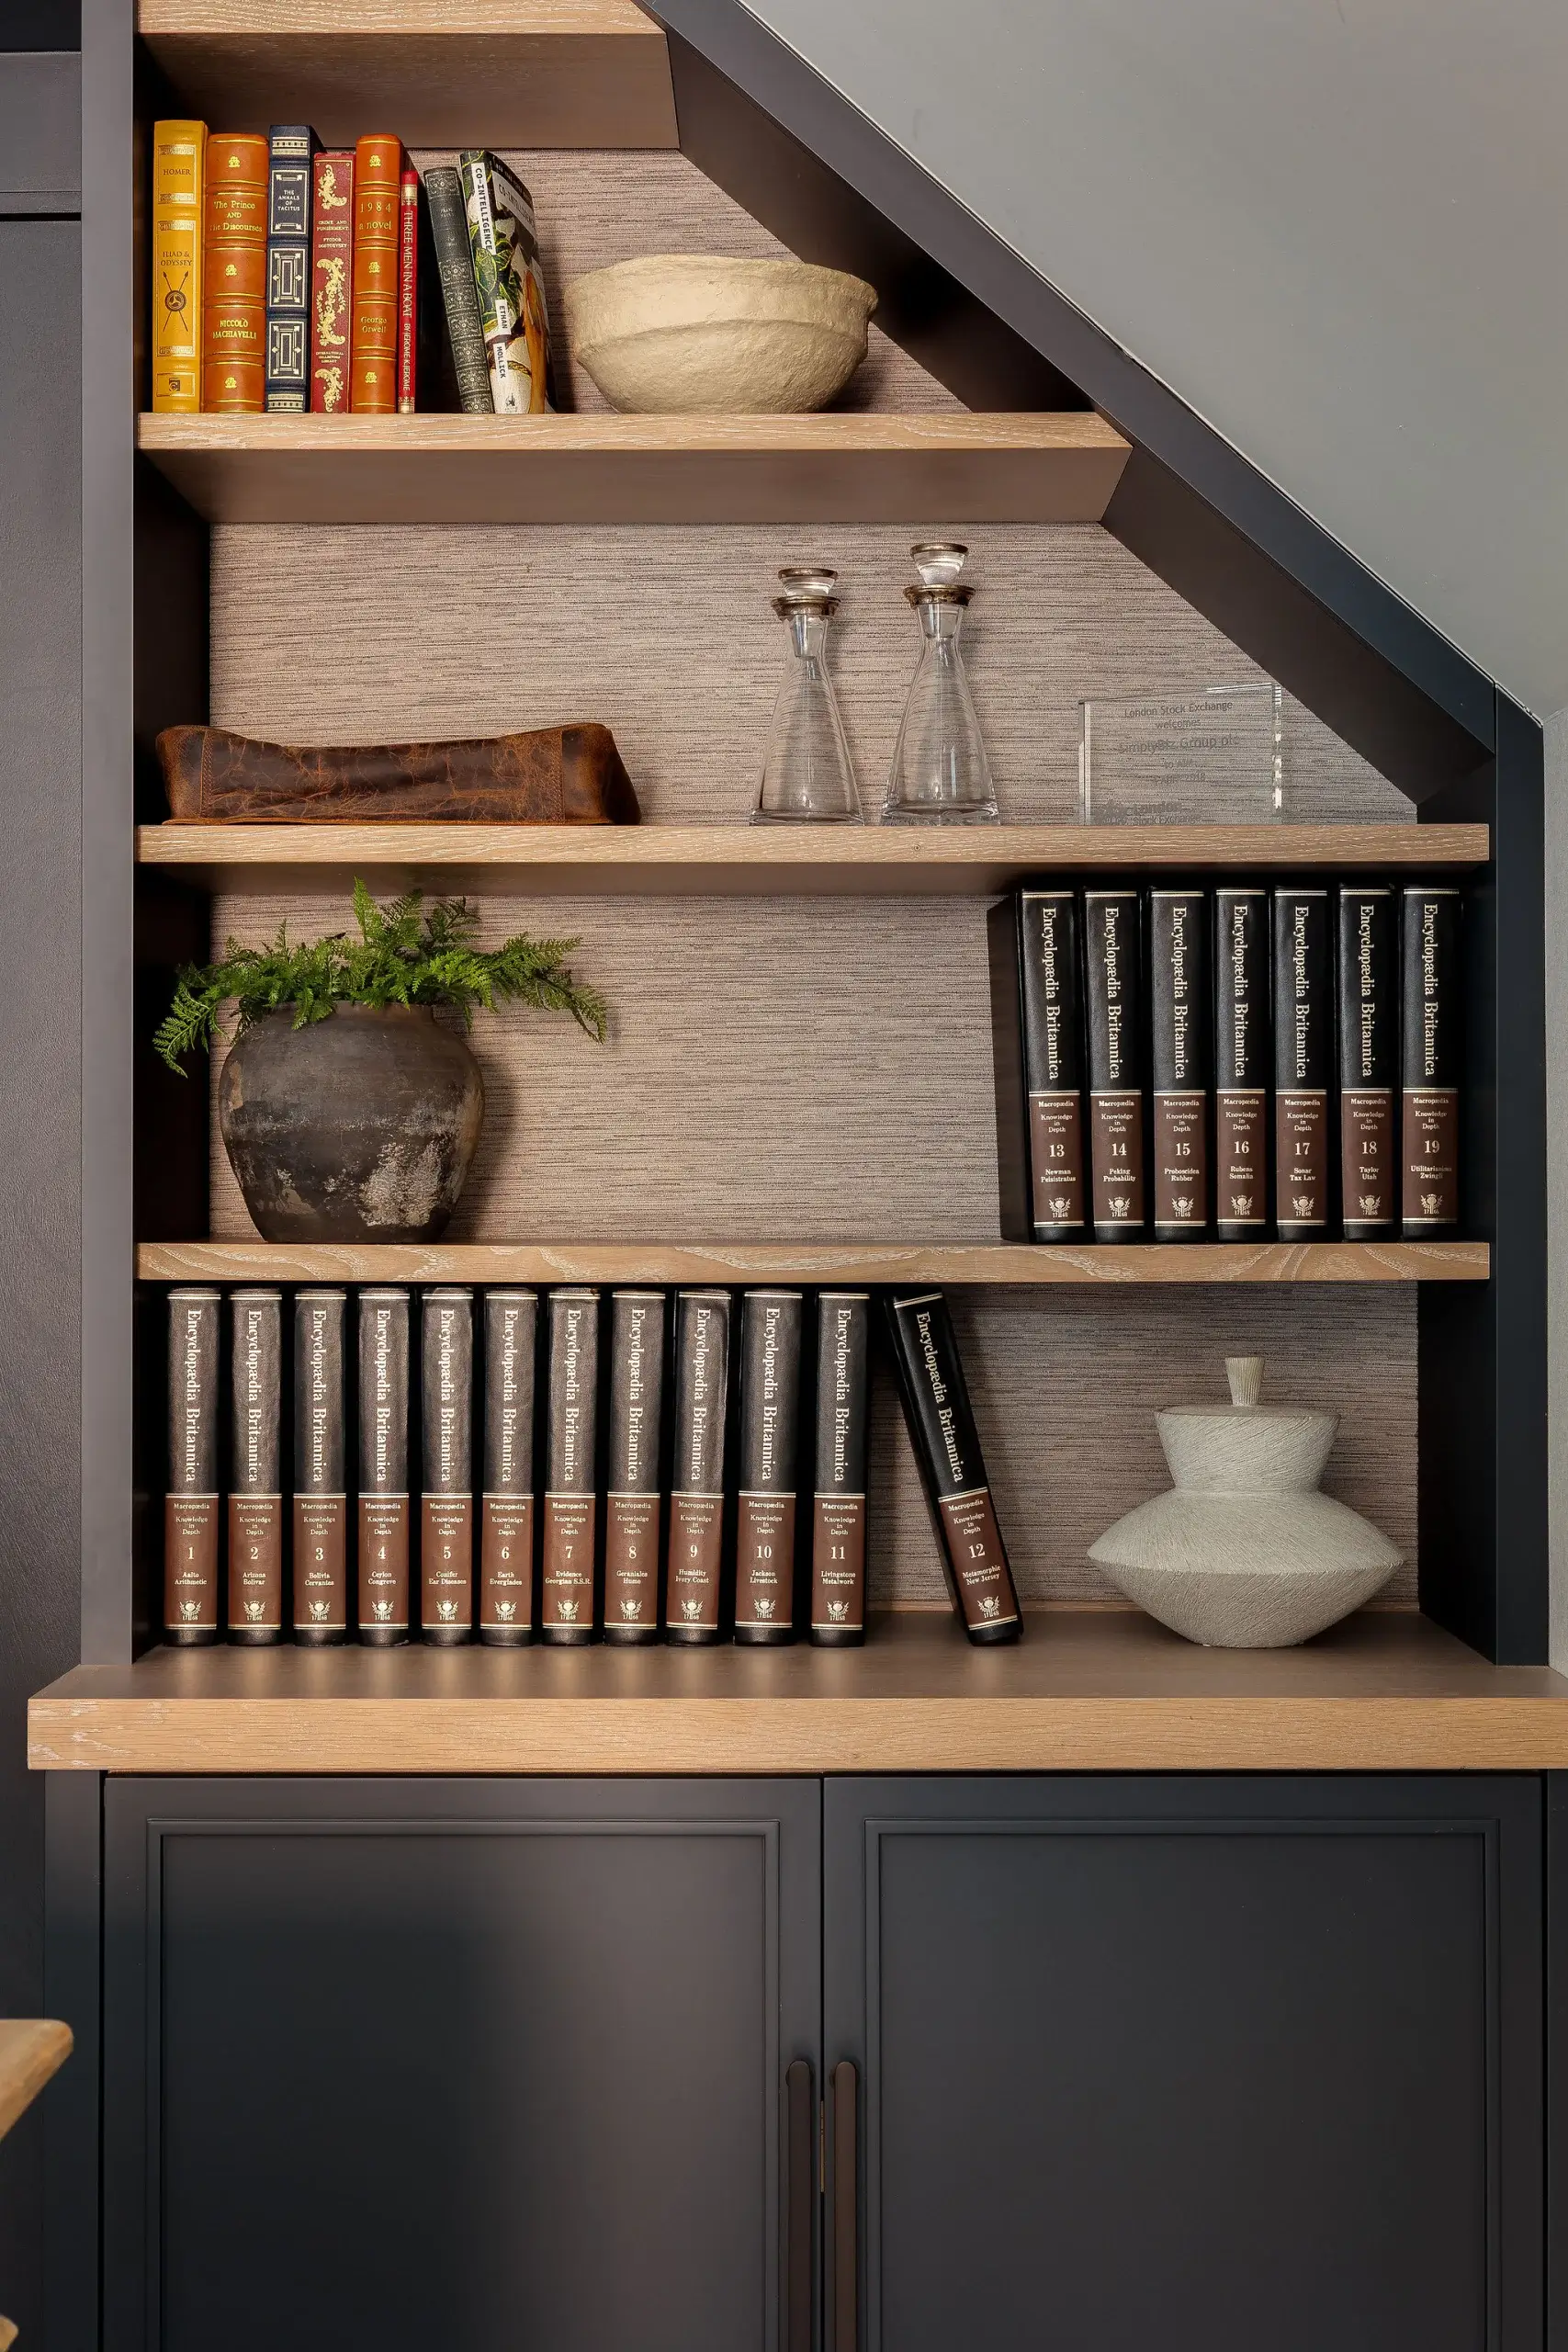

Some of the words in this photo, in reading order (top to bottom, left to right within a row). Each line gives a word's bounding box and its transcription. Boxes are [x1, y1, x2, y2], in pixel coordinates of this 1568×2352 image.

[213, 200, 229, 209] The
[231, 199, 255, 209] Prince
[475, 167, 492, 250] CO-INTELLIGENCE
[222, 222, 263, 232] Discourses
[367, 220, 392, 230] novel
[403, 211, 413, 243] THREE
[403, 246, 413, 269] MEN
[403, 271, 412, 282] IN
[402, 292, 412, 318] BOAT
[220, 317, 249, 328] NICCOLÒ
[360, 316, 388, 325] George
[499, 305, 508, 329] ETHAN
[212, 330, 256, 340] MACHIAVELLI
[362, 325, 387, 334] Orwell
[403, 322, 412, 332] BY
[402, 332, 412, 358] JEROME
[496, 346, 506, 379] MOLLICK
[402, 366, 411, 390] JEROME
[1124, 708, 1157, 718] London
[1160, 705, 1186, 716] Stock
[1189, 701, 1233, 713] Exchange
[1155, 719, 1201, 729] welcomes
[1179, 736, 1217, 752] Group
[1041, 908, 1060, 1000] Encyclopædia
[1103, 907, 1121, 999] Encyclopædia
[1170, 907, 1188, 999] Encyclopædia
[1231, 905, 1247, 997] Encyclopædia
[1292, 906, 1309, 998] Encyclopædia
[1358, 905, 1374, 997] Encyclopædia
[1421, 904, 1438, 996] Encyclopædia
[1046, 1005, 1062, 1080] Britannica
[1108, 1004, 1122, 1079] Britannica
[1174, 1004, 1189, 1079] Britannica
[1234, 1003, 1248, 1078] Britannica
[1295, 1003, 1309, 1078] Britannica
[1361, 1003, 1376, 1079] Britannica
[1424, 1001, 1438, 1076] Britannica
[1049, 1144, 1066, 1158] 13
[1111, 1142, 1127, 1157] 14
[1175, 1142, 1191, 1156] 15
[1234, 1140, 1250, 1154] 16
[1294, 1142, 1311, 1156] 17
[1361, 1140, 1378, 1155] 18
[1424, 1139, 1440, 1154] 19
[1044, 1168, 1071, 1176] Newman
[1109, 1168, 1131, 1176] Peking
[1359, 1166, 1380, 1174] Taylor
[1419, 1171, 1444, 1180] Zwingli
[1102, 1174, 1136, 1183] Probability
[185, 1309, 202, 1402] Encyclopædia
[246, 1309, 263, 1402] Encyclopædia
[310, 1309, 327, 1402] Encyclopædia
[375, 1309, 391, 1401] Encyclopædia
[439, 1309, 455, 1401] Encyclopædia
[502, 1309, 518, 1401] Encyclopædia
[564, 1309, 581, 1401] Encyclopædia
[627, 1309, 645, 1401] Encyclopædia
[694, 1308, 711, 1401] Encyclopædia
[762, 1307, 780, 1400] Encyclopædia
[834, 1308, 851, 1401] Encyclopædia
[916, 1310, 945, 1404] Encyclopædia
[938, 1407, 964, 1483] Britannica
[186, 1408, 200, 1483] Britannica
[248, 1408, 263, 1483] Britannica
[312, 1408, 327, 1483] Britannica
[376, 1408, 391, 1483] Britannica
[441, 1408, 455, 1483] Britannica
[502, 1408, 516, 1483] Britannica
[564, 1408, 580, 1482] Britannica
[627, 1407, 644, 1482] Britannica
[691, 1407, 707, 1481] Britannica
[762, 1406, 778, 1481] Britannica
[834, 1407, 850, 1482] Britannica
[186, 1546, 196, 1560] 1
[249, 1546, 259, 1560] 2
[314, 1546, 324, 1561] 3
[377, 1545, 388, 1560] 4
[443, 1545, 452, 1560] 5
[501, 1545, 510, 1560] 6
[564, 1545, 573, 1559] 7
[627, 1544, 637, 1559] 8
[689, 1544, 698, 1558] 9
[755, 1544, 773, 1559] 10
[830, 1545, 846, 1560] 11
[968, 1543, 986, 1559] 12
[309, 1571, 331, 1579] Bolivia
[675, 1576, 693, 1584] Ivory
[678, 1568, 707, 1577] Humidity
[751, 1569, 776, 1577] Jackson
[820, 1570, 856, 1578] Livingstone
[962, 1565, 1001, 1579] Metamorphic
[966, 1577, 980, 1587] New
[981, 1573, 1000, 1585] Jersey
[174, 1577, 208, 1586] Arithmetic
[304, 1578, 334, 1587] Cervantes
[490, 1577, 523, 1587] Everglades
[545, 1577, 572, 1587] Georgian
[623, 1577, 641, 1585] Hume
[750, 1577, 778, 1585] Livestock
